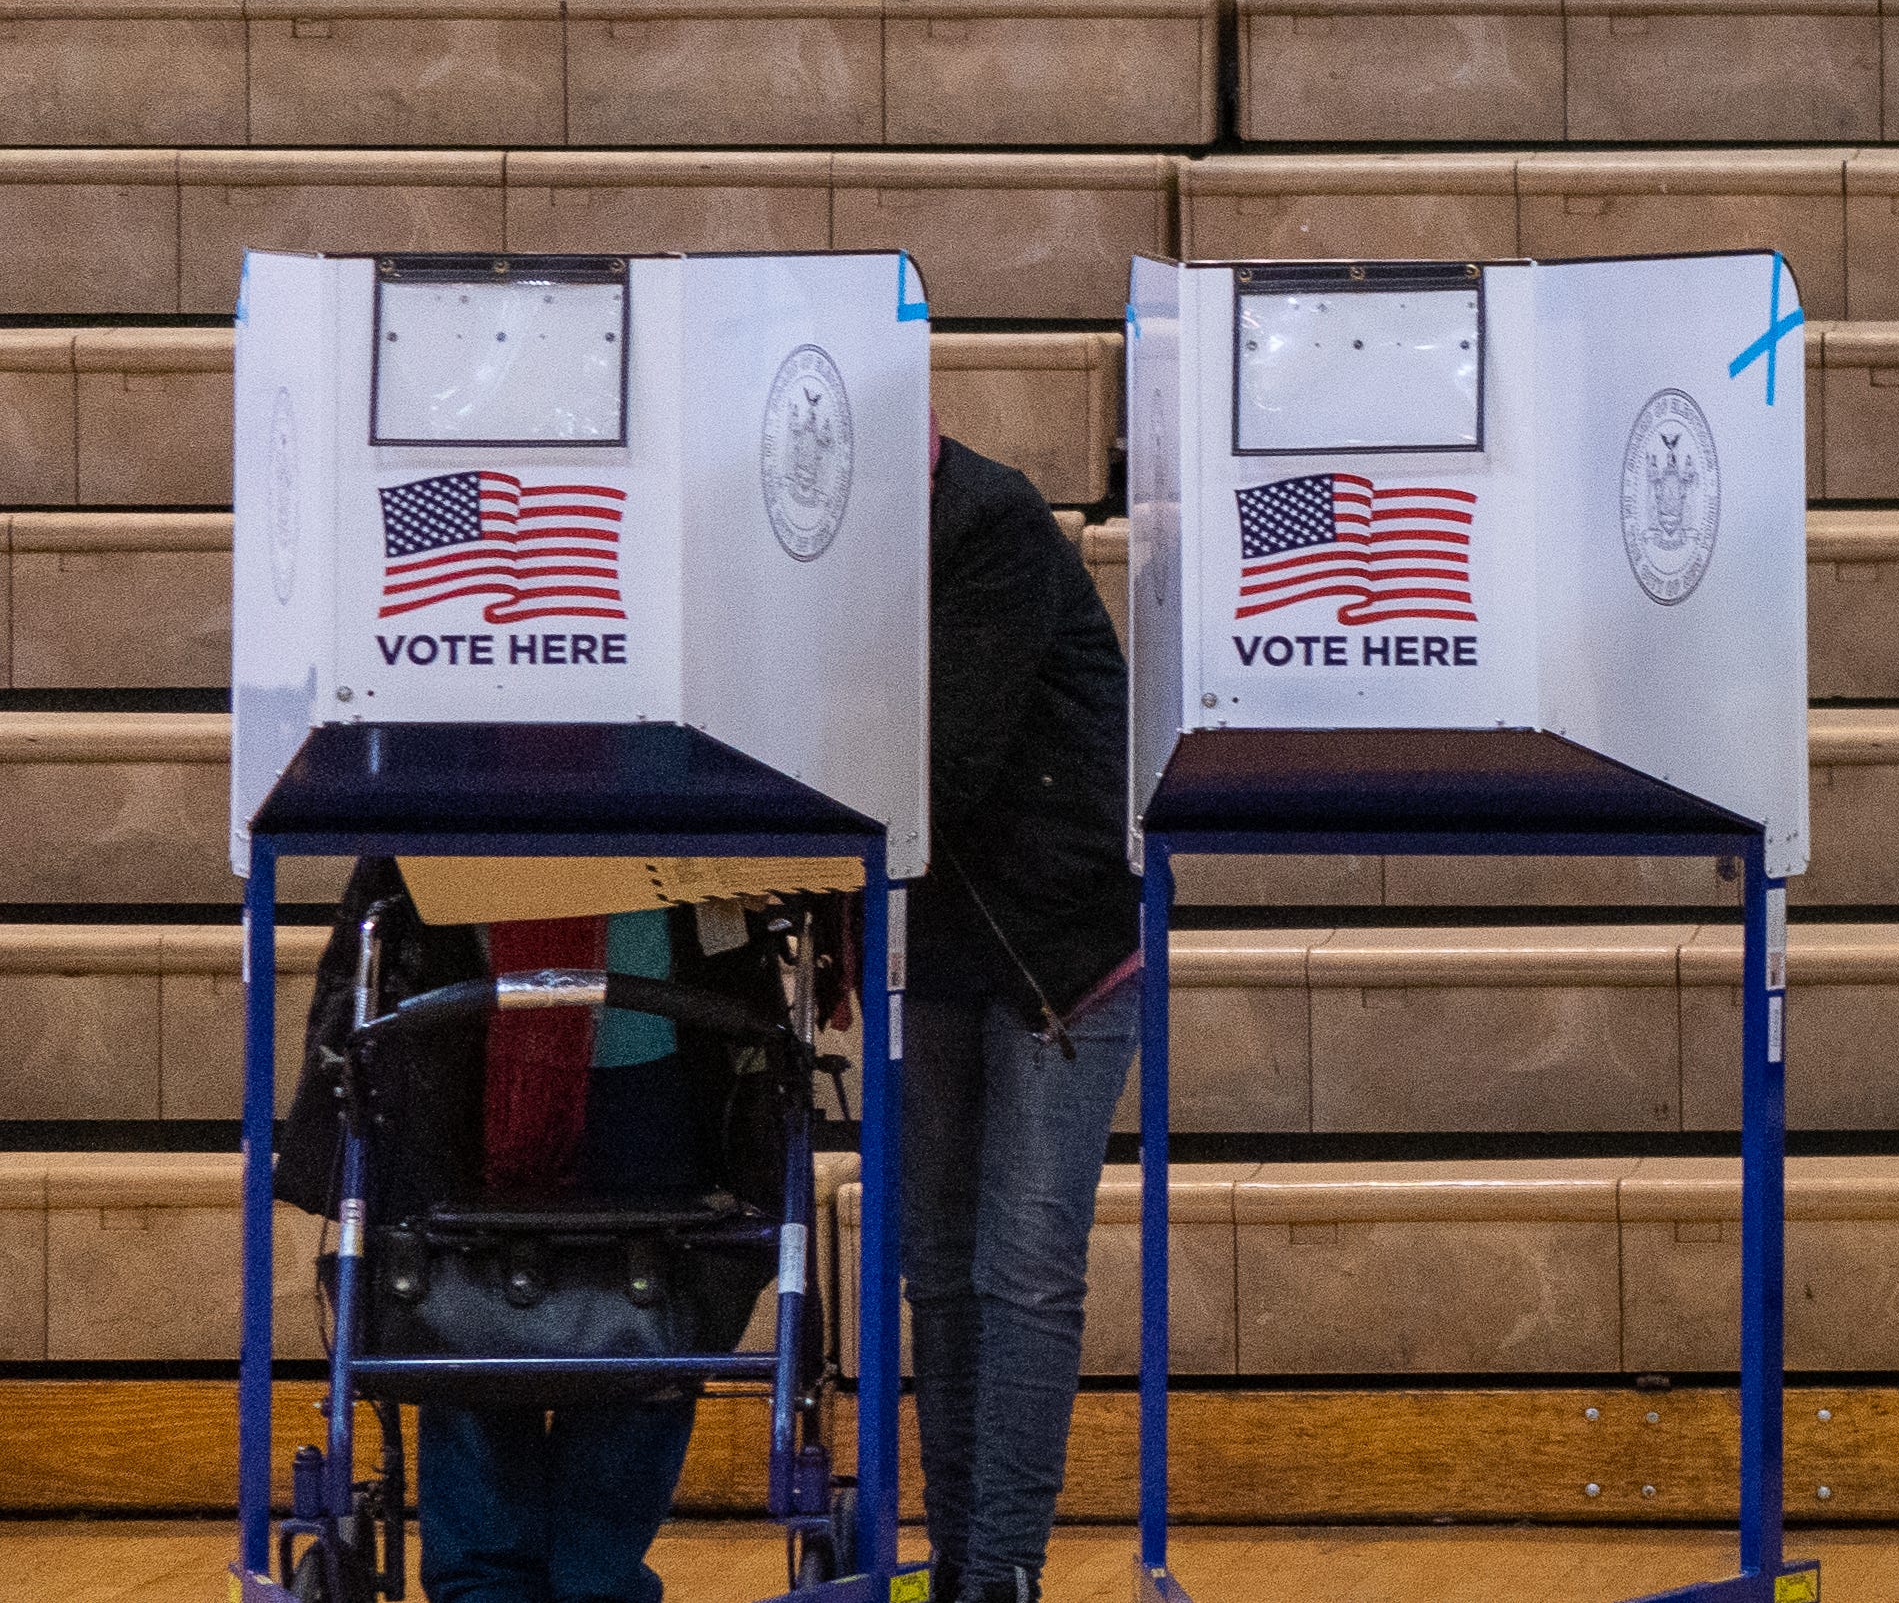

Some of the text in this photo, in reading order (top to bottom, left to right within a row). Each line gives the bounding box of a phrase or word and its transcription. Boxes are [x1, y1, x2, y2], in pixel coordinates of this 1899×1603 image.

[374, 633, 628, 666] VOTE HERE
[1232, 635, 1479, 667] VOTE HERE
